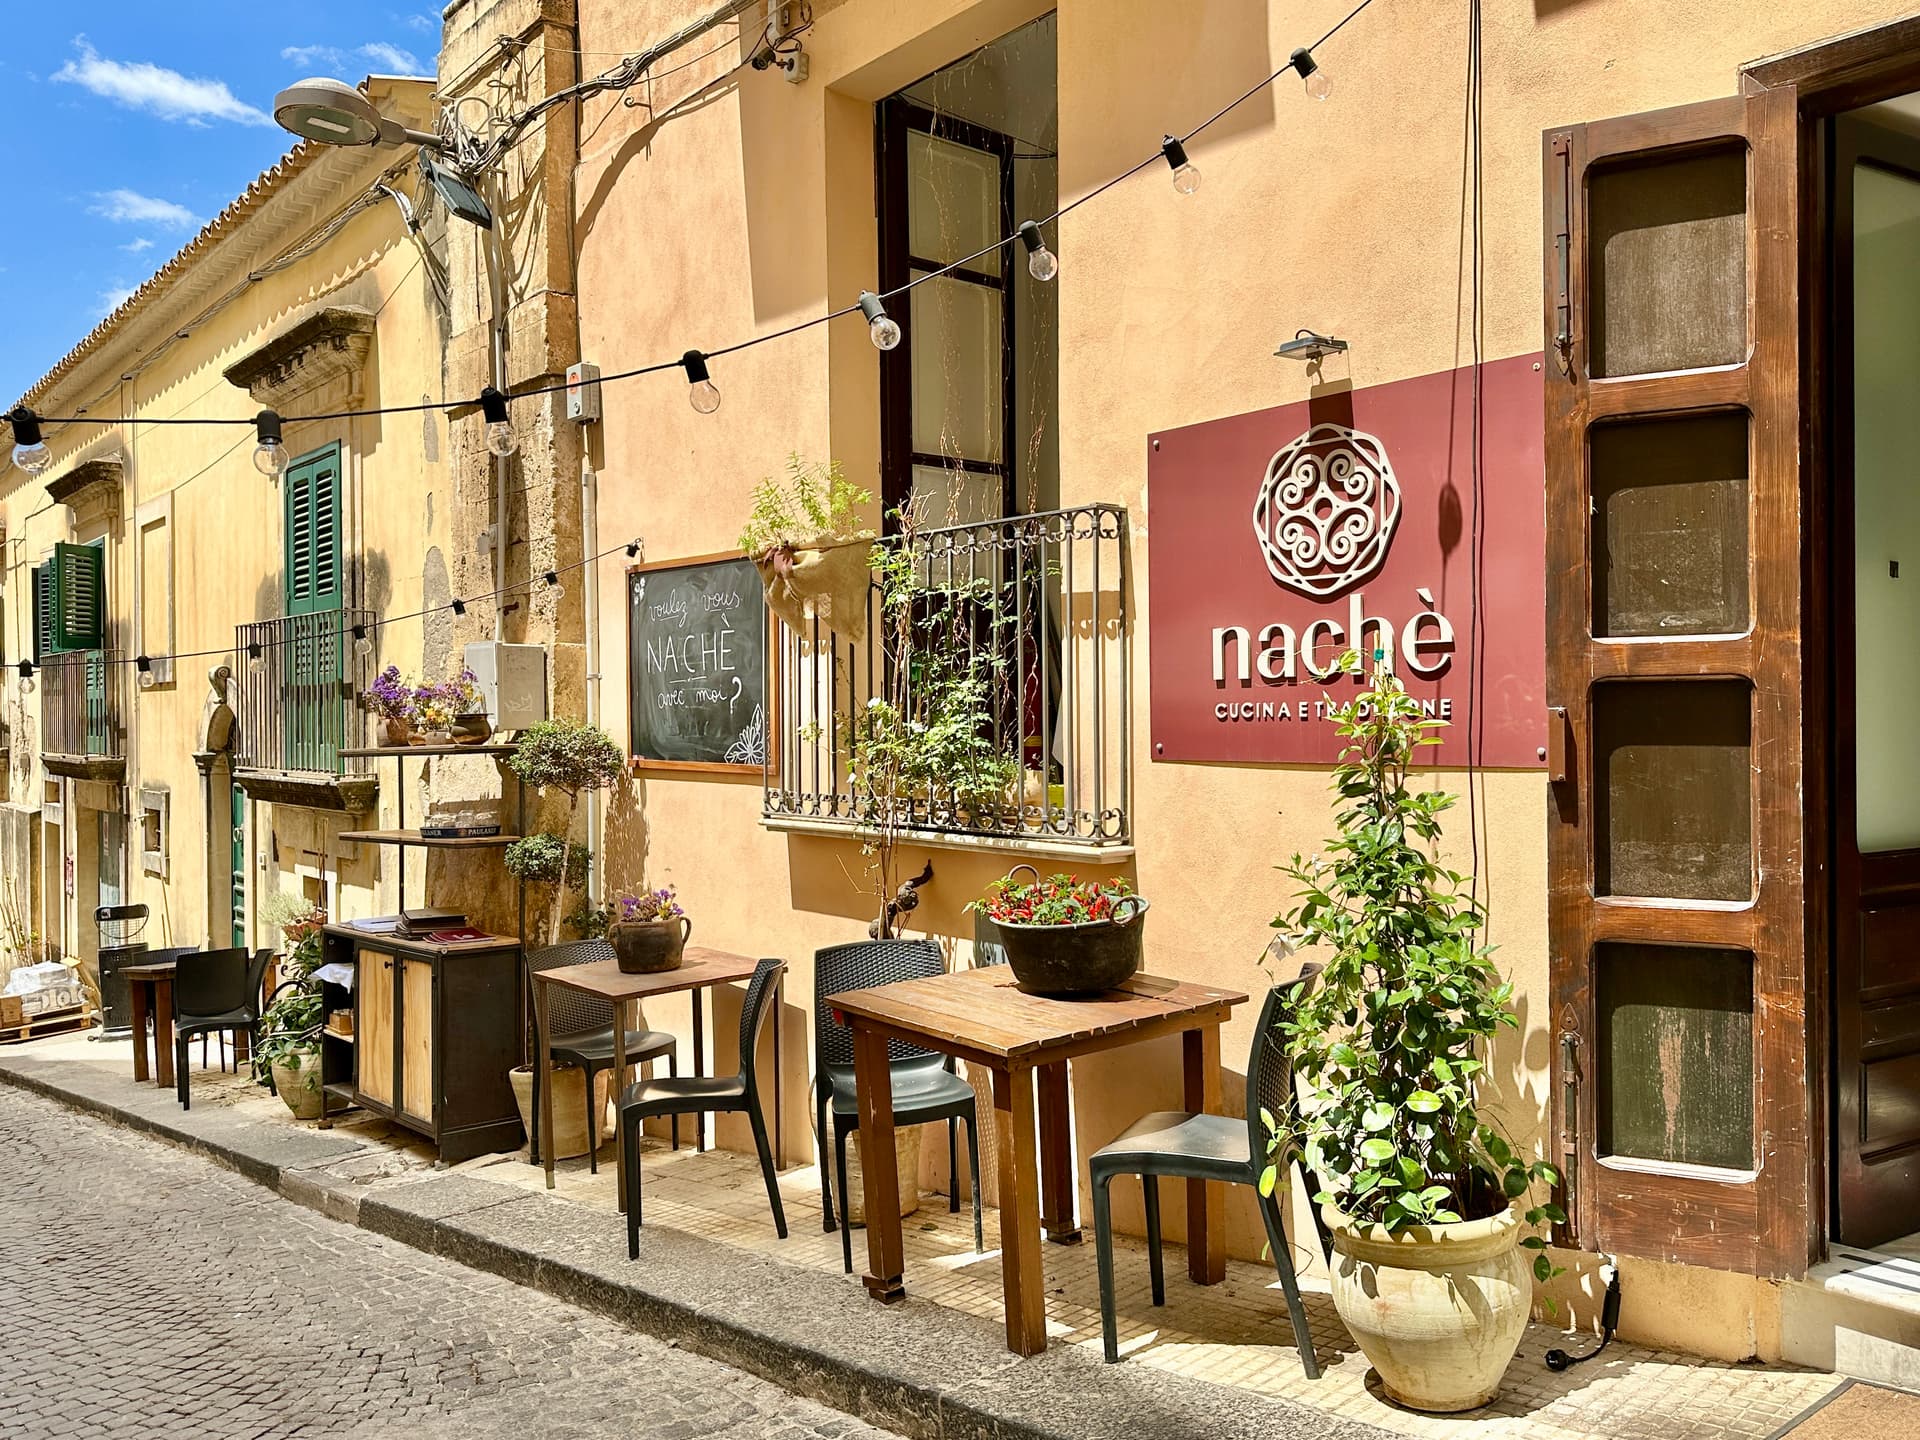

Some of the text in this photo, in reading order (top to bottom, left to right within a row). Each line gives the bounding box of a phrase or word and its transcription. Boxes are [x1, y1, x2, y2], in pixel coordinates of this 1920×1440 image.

[649, 588, 741, 628] voulez vous
[647, 613, 736, 673] NACHÈ
[1212, 588, 1456, 682] nachè
[658, 689, 685, 709] avec
[1214, 698, 1452, 720] CUCINA E TRADIONE
